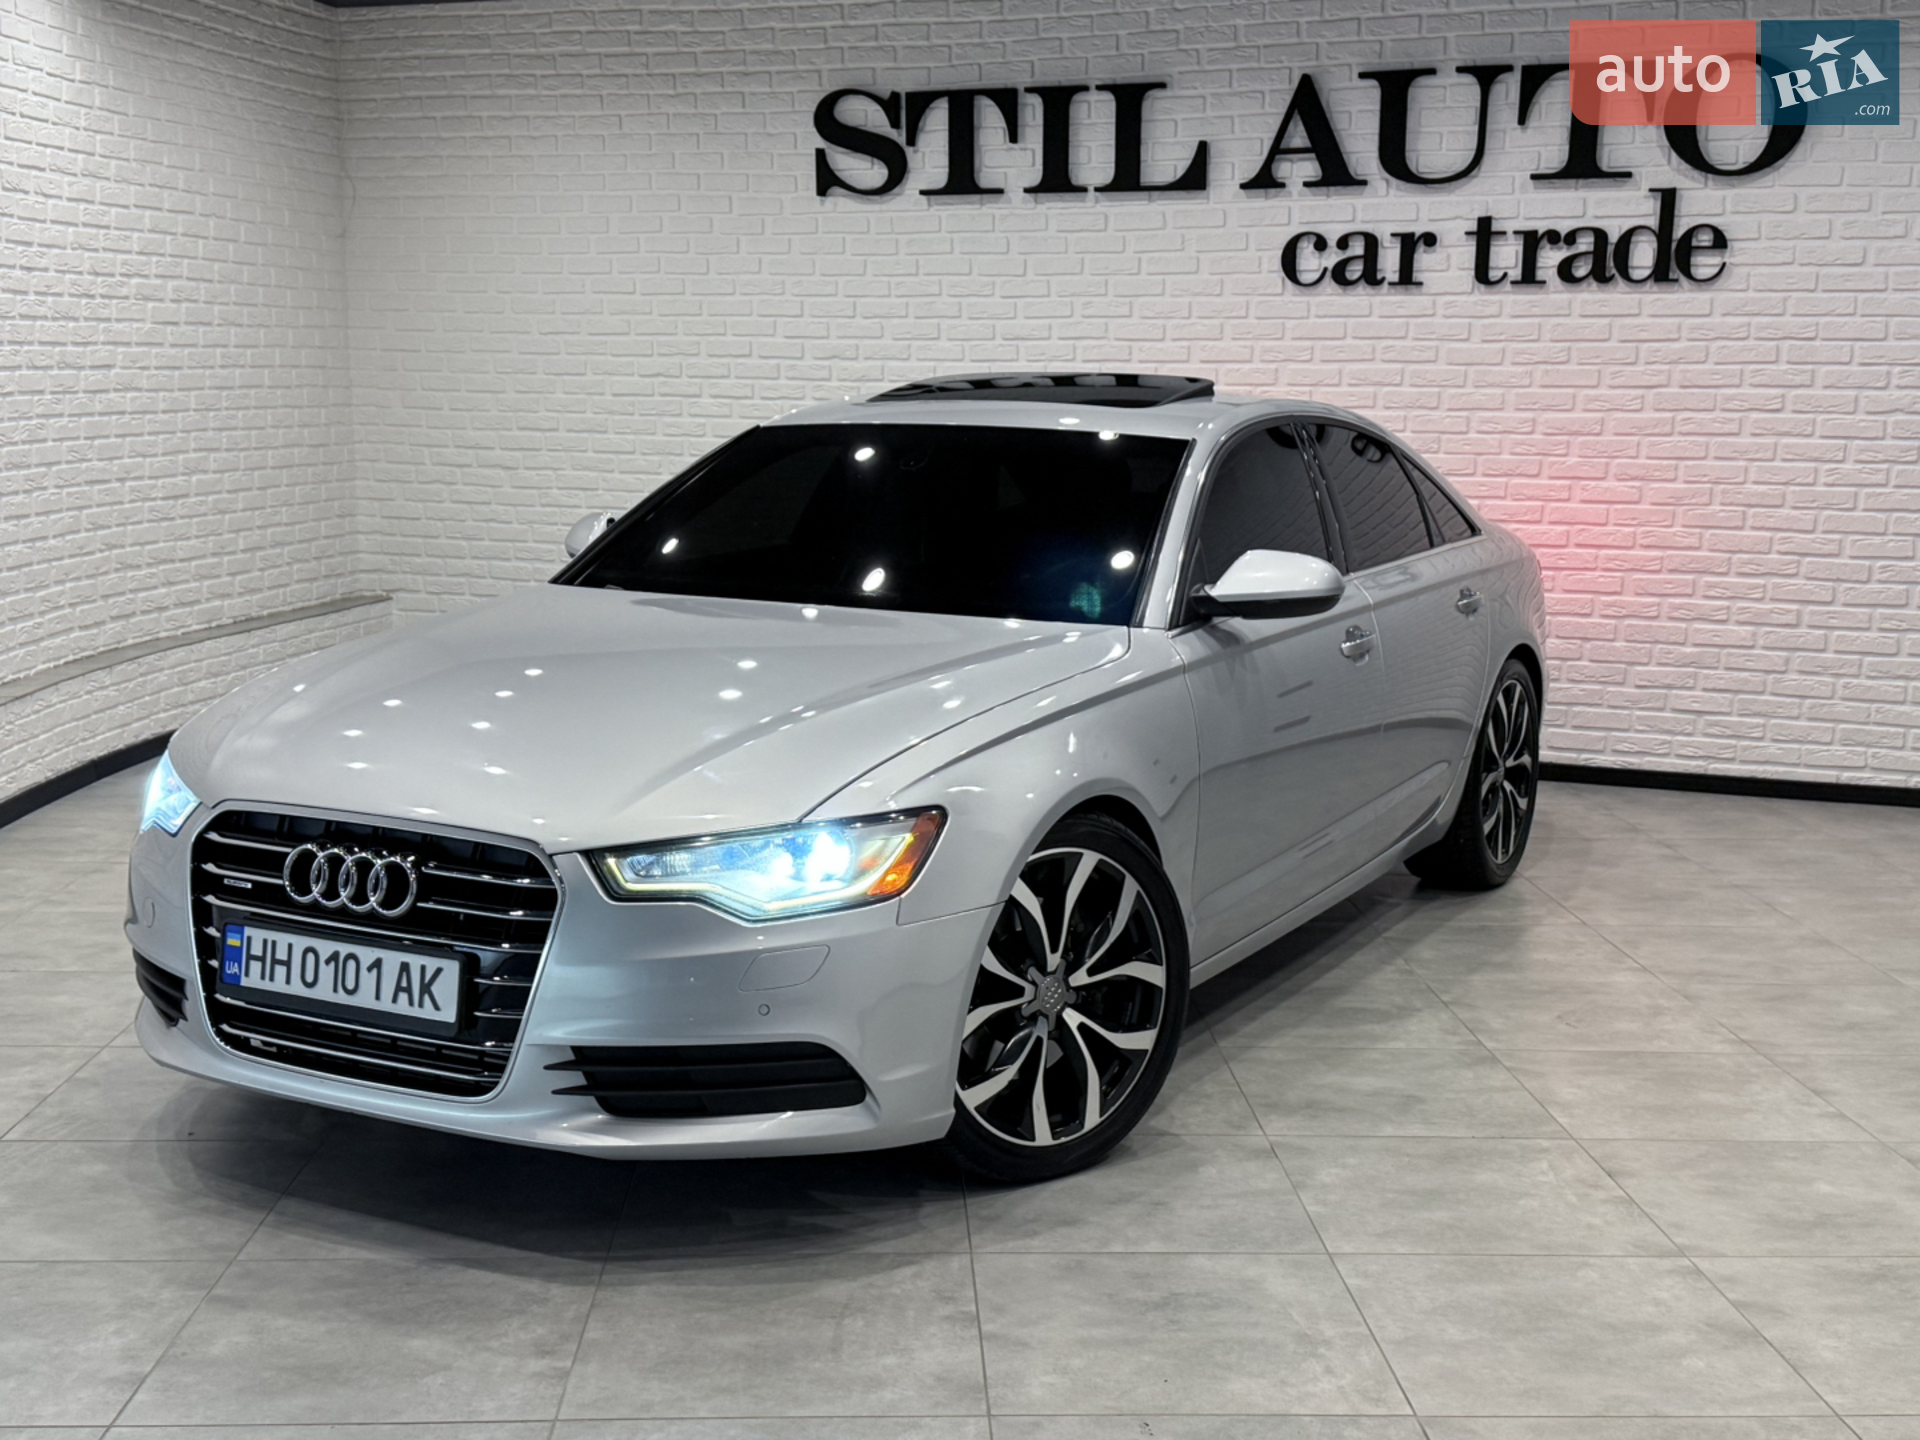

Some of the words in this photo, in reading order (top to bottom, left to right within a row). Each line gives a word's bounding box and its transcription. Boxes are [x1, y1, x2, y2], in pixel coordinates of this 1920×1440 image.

[814, 83, 1207, 196] STIL
[1239, 53, 1808, 188] AUTO
[1281, 231, 1437, 288] car
[1465, 188, 1728, 286] trade
[225, 961, 240, 975] UA
